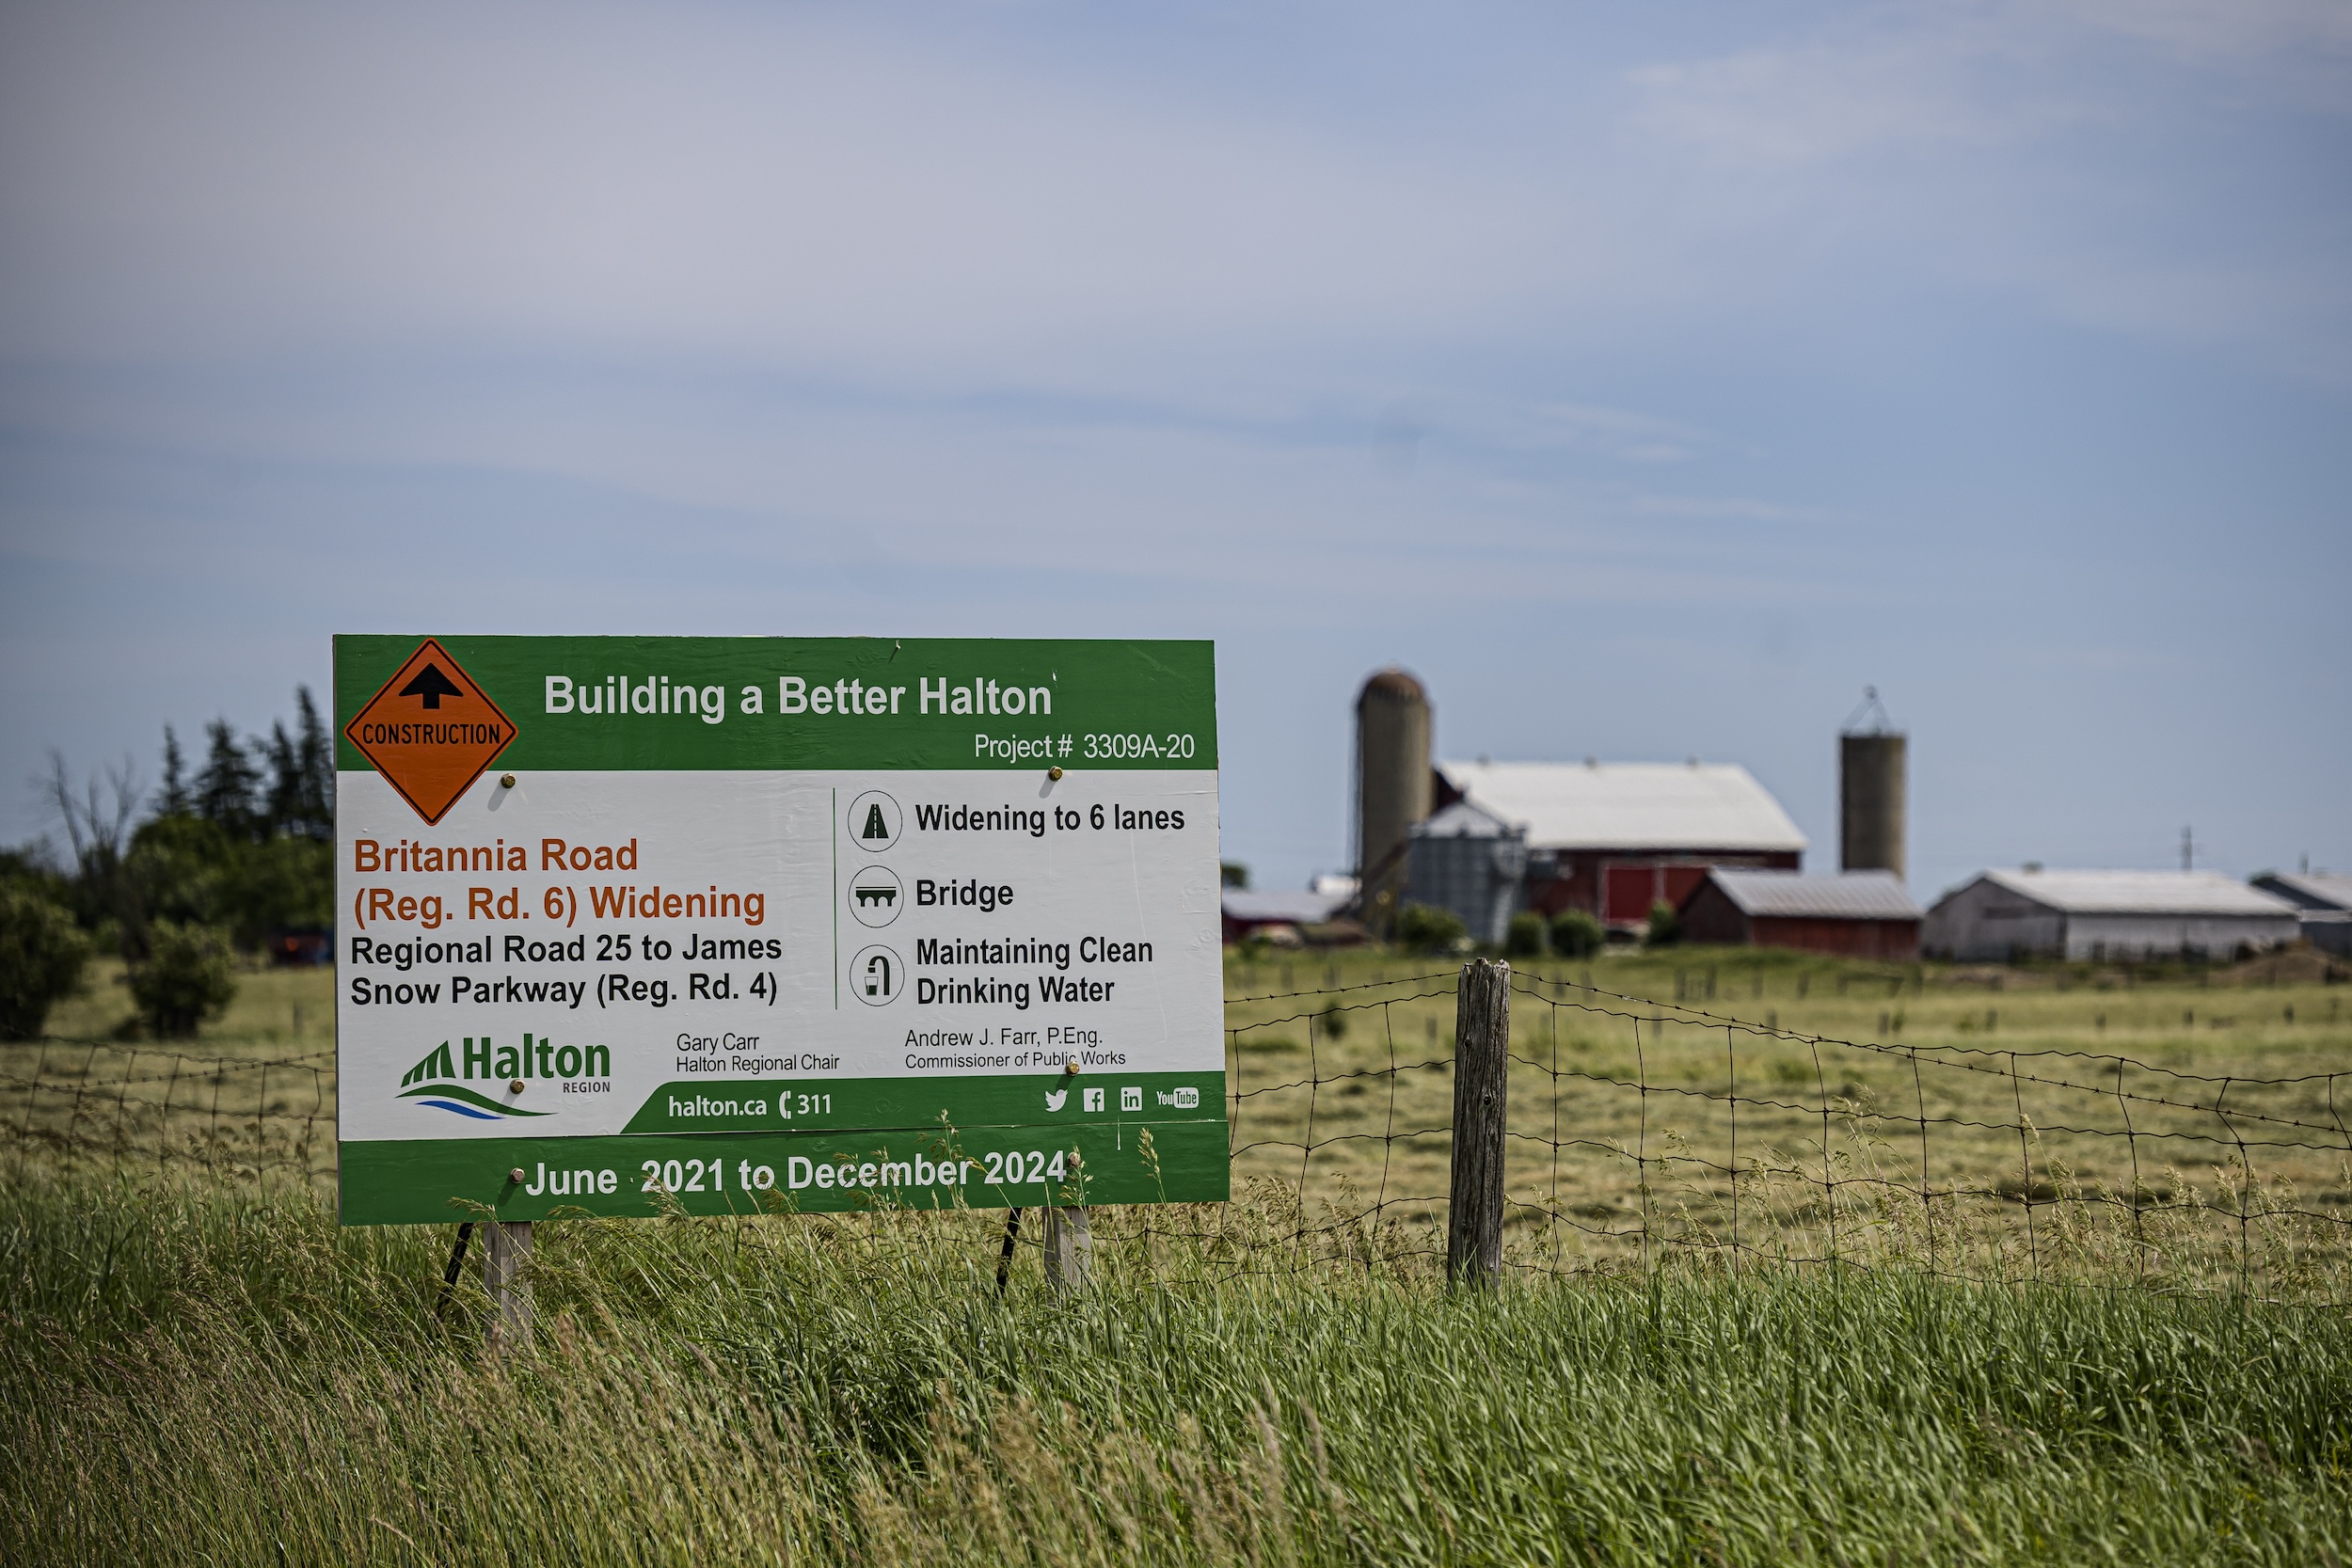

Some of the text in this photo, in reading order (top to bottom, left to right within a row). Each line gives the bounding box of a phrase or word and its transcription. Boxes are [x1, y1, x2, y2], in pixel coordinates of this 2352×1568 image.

[546, 676, 1051, 724] Building a Better Halton
[363, 723, 500, 744] CONSTRUCTION
[976, 734, 1194, 764] Project # 3309A-20
[915, 804, 1184, 837] Widening to 6 lanes
[356, 838, 637, 872] Britannia Road
[355, 886, 764, 929] (Reg. Rd. 6) Widening
[917, 879, 1013, 912] Bridge
[352, 934, 781, 971] Regional Road 25 to James
[917, 937, 1152, 970] Maintaining Clean
[352, 973, 776, 1008] Snow Parkway (Reg. Rd. 4)
[918, 976, 1115, 1009] Drinking Water
[677, 1033, 759, 1055] Gary Carr
[905, 1027, 1102, 1048] Andrew J. Farr, P.Eng.
[464, 1034, 610, 1079] Halton
[677, 1054, 839, 1074] Halton Regional Chair
[906, 1054, 1009, 1068] Commissioner
[1015, 1053, 1028, 1066] of
[1081, 1051, 1125, 1065] Works
[564, 1082, 610, 1093] REGION
[1156, 1088, 1199, 1107] YouTube
[670, 1095, 830, 1117] halton.ca 311
[526, 1150, 1067, 1196] June 2021 to December 2024
